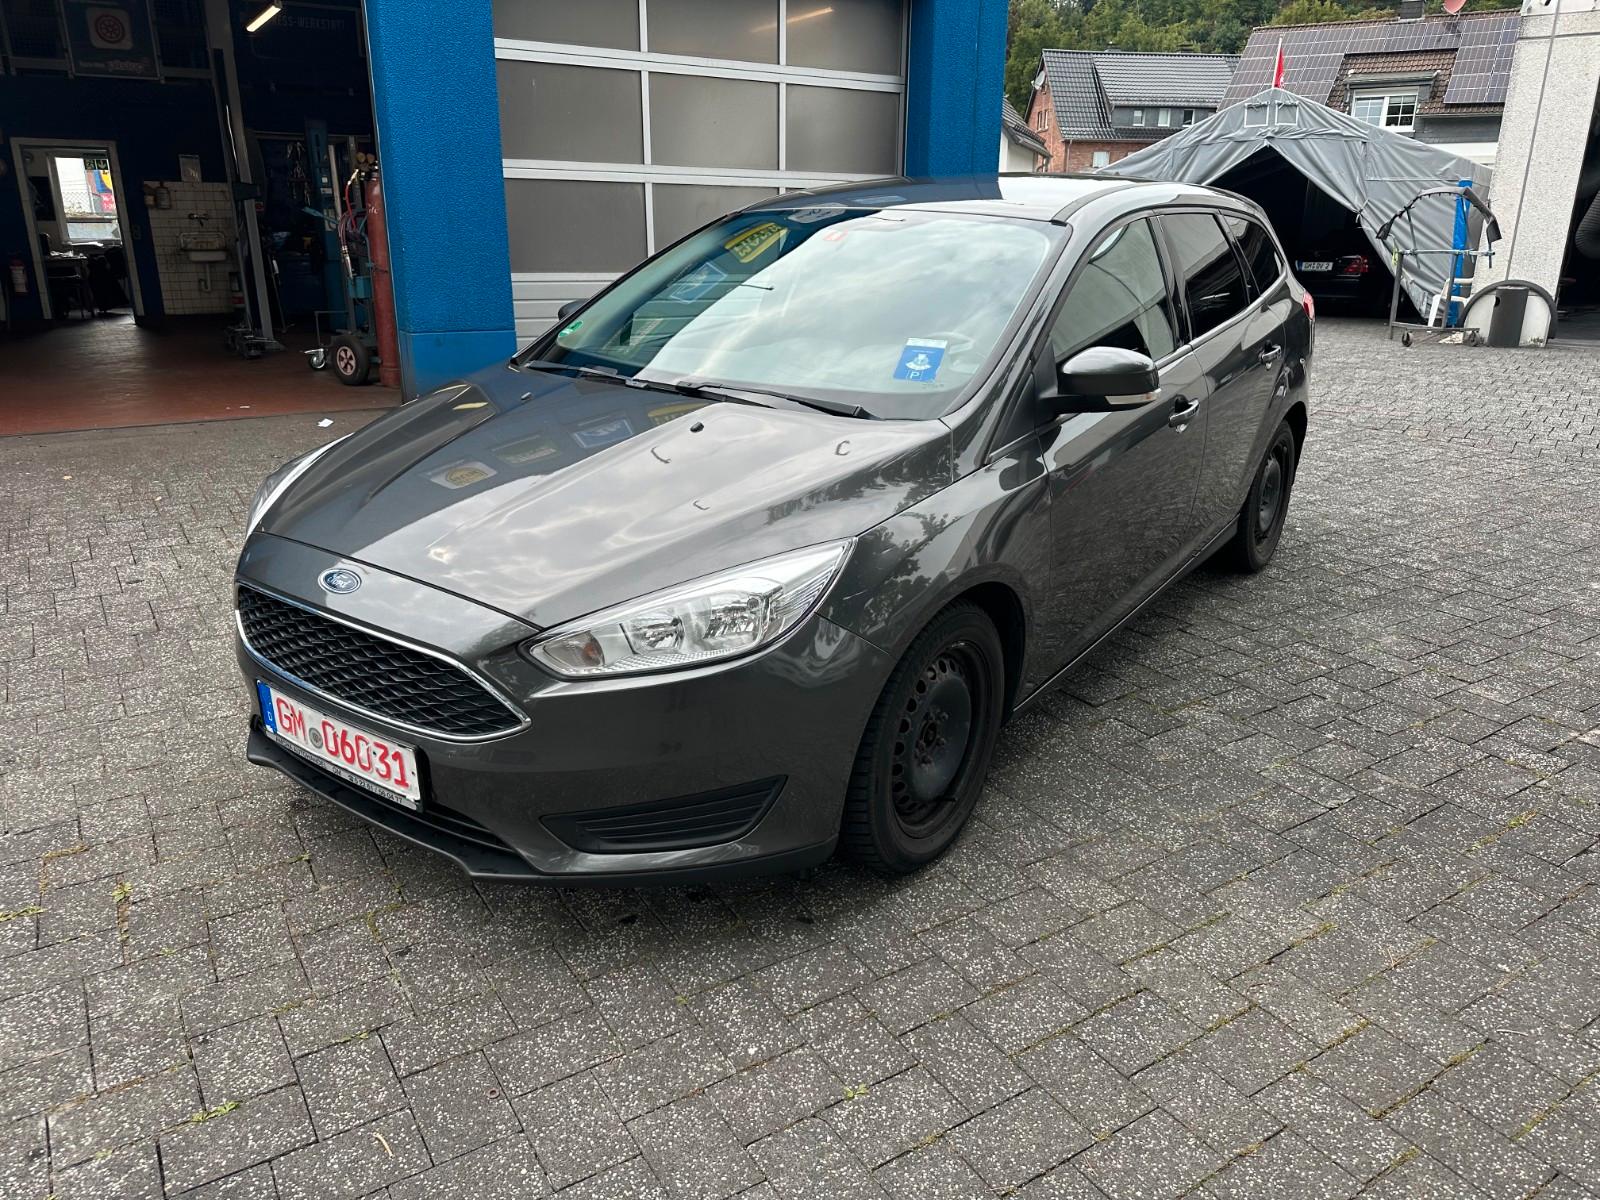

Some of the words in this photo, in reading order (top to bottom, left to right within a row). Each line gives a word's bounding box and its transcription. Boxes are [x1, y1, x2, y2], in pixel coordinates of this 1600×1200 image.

[909, 371, 920, 380] P
[327, 572, 352, 589] Ford
[276, 696, 307, 742] GM
[321, 719, 410, 789] 06031
